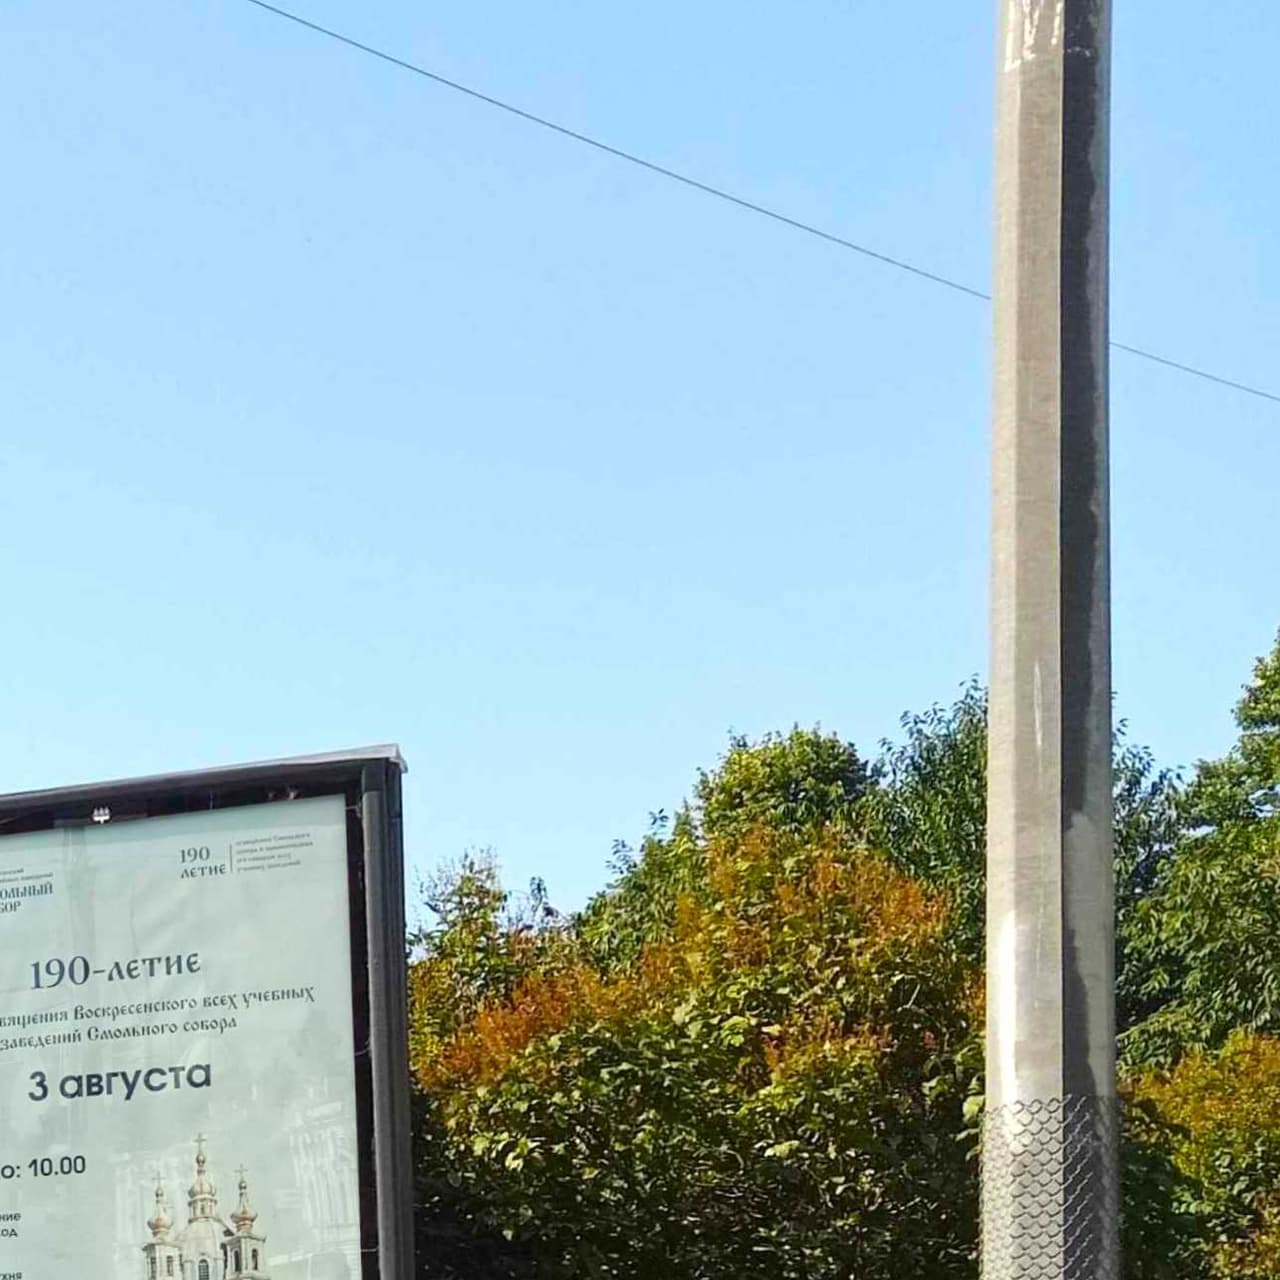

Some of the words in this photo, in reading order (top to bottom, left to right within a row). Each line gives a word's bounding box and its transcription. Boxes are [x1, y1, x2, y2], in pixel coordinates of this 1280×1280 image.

[179, 846, 211, 863] 190
[30, 952, 201, 990] 190-летие
[74, 998, 198, 1022] Воскресенского
[202, 992, 238, 1010] всех
[242, 986, 316, 1009] учебных
[0, 1029, 82, 1051] заведений
[87, 1021, 178, 1041] Смольного
[182, 1016, 238, 1035] собора
[28, 1070, 49, 1102] 3
[59, 1061, 212, 1101] августа
[28, 1155, 86, 1177] 10.00
